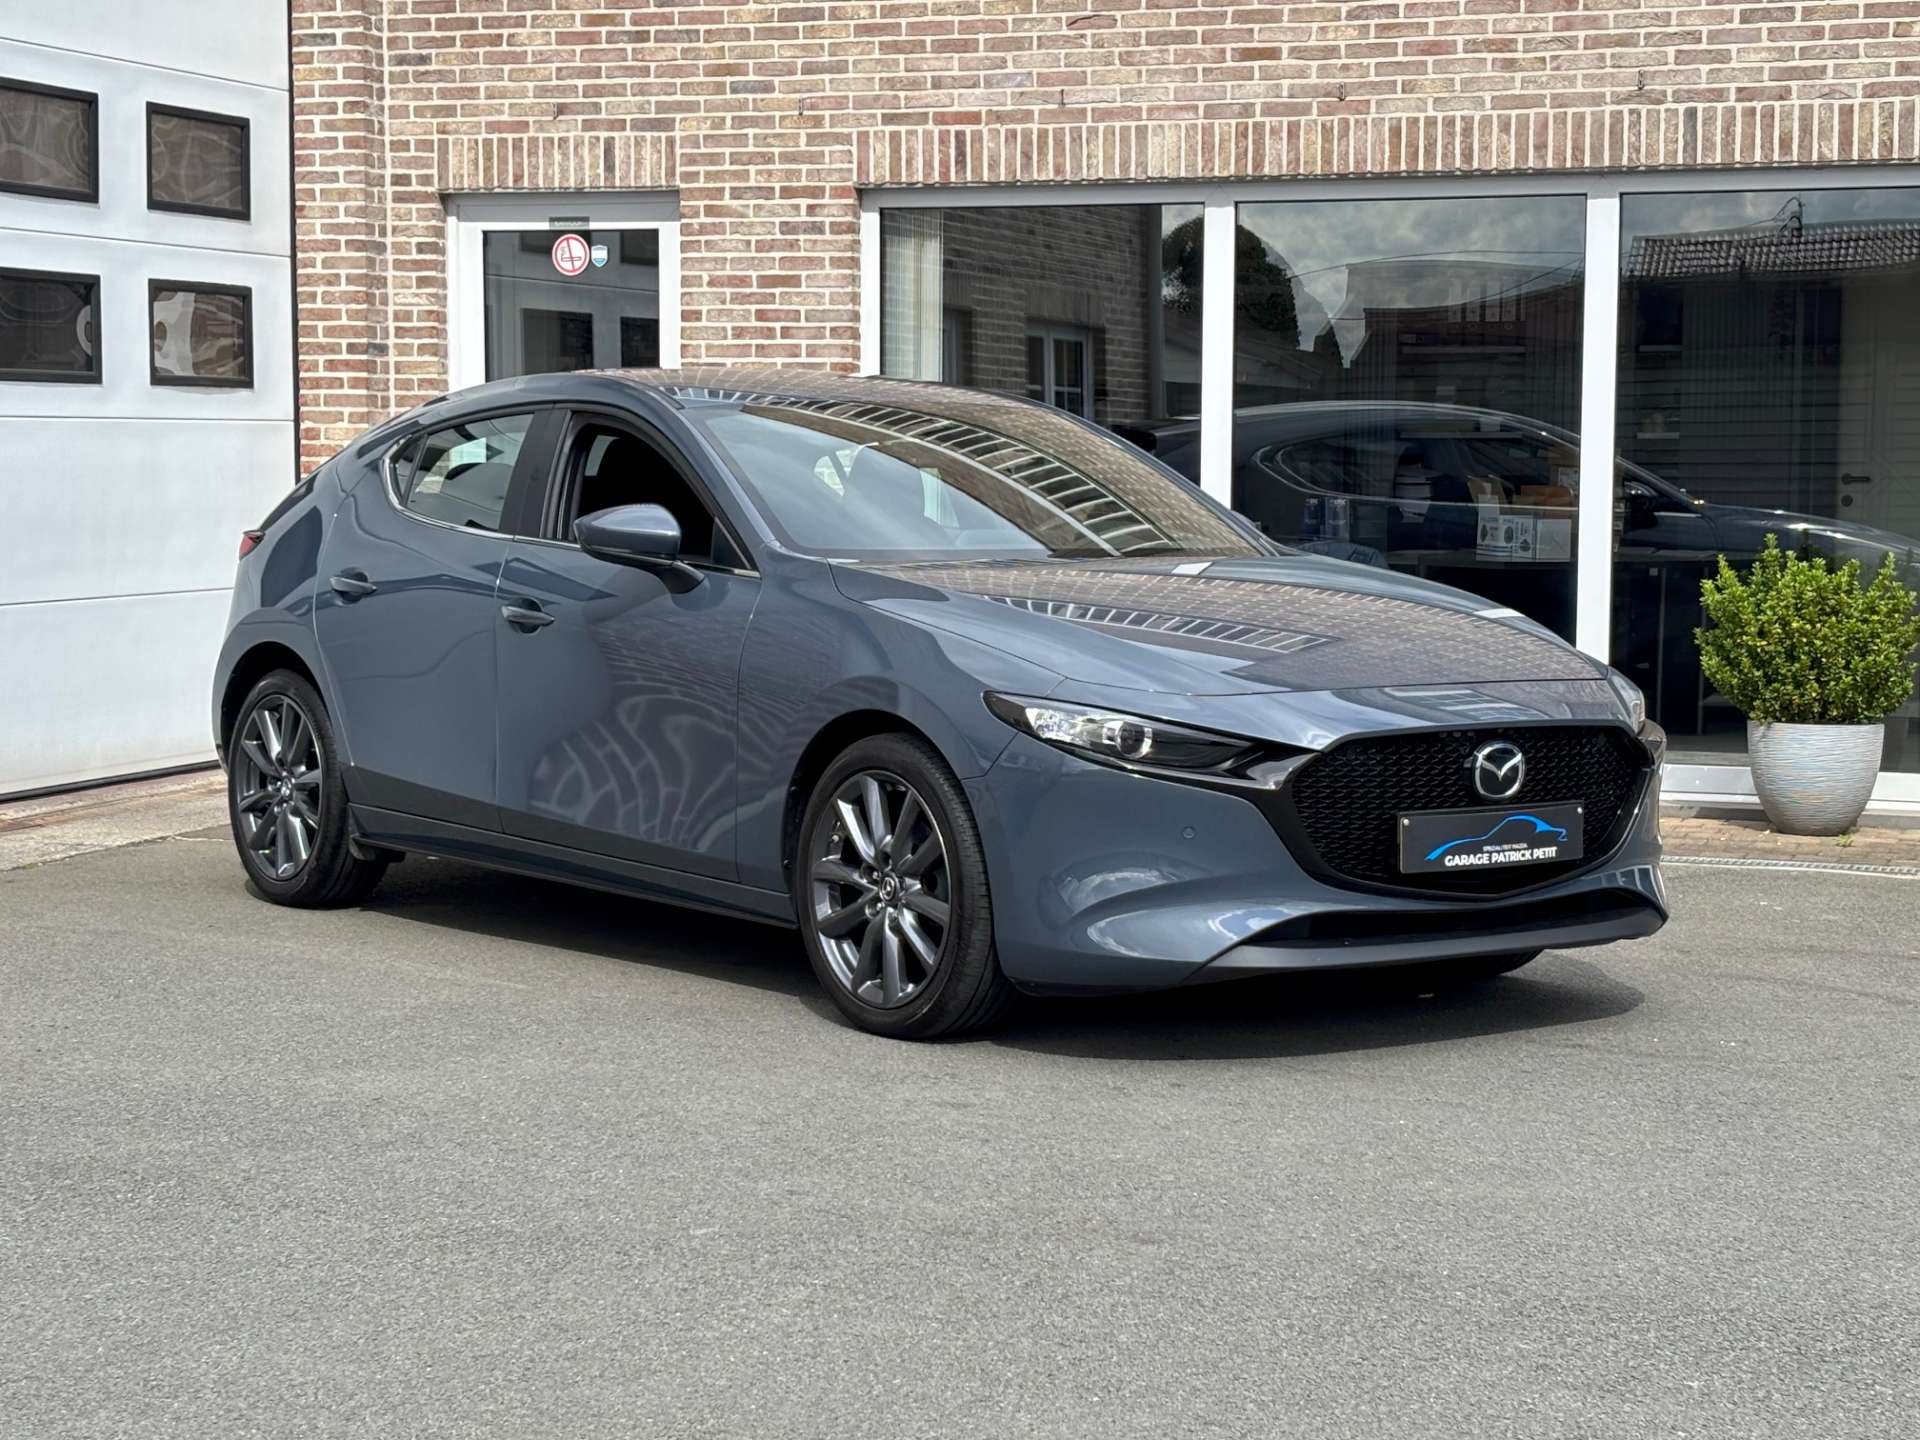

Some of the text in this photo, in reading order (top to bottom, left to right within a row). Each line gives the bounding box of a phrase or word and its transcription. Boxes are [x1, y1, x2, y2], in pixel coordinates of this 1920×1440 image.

[1444, 847, 1557, 866] GARAGE PATRICK PETIT
